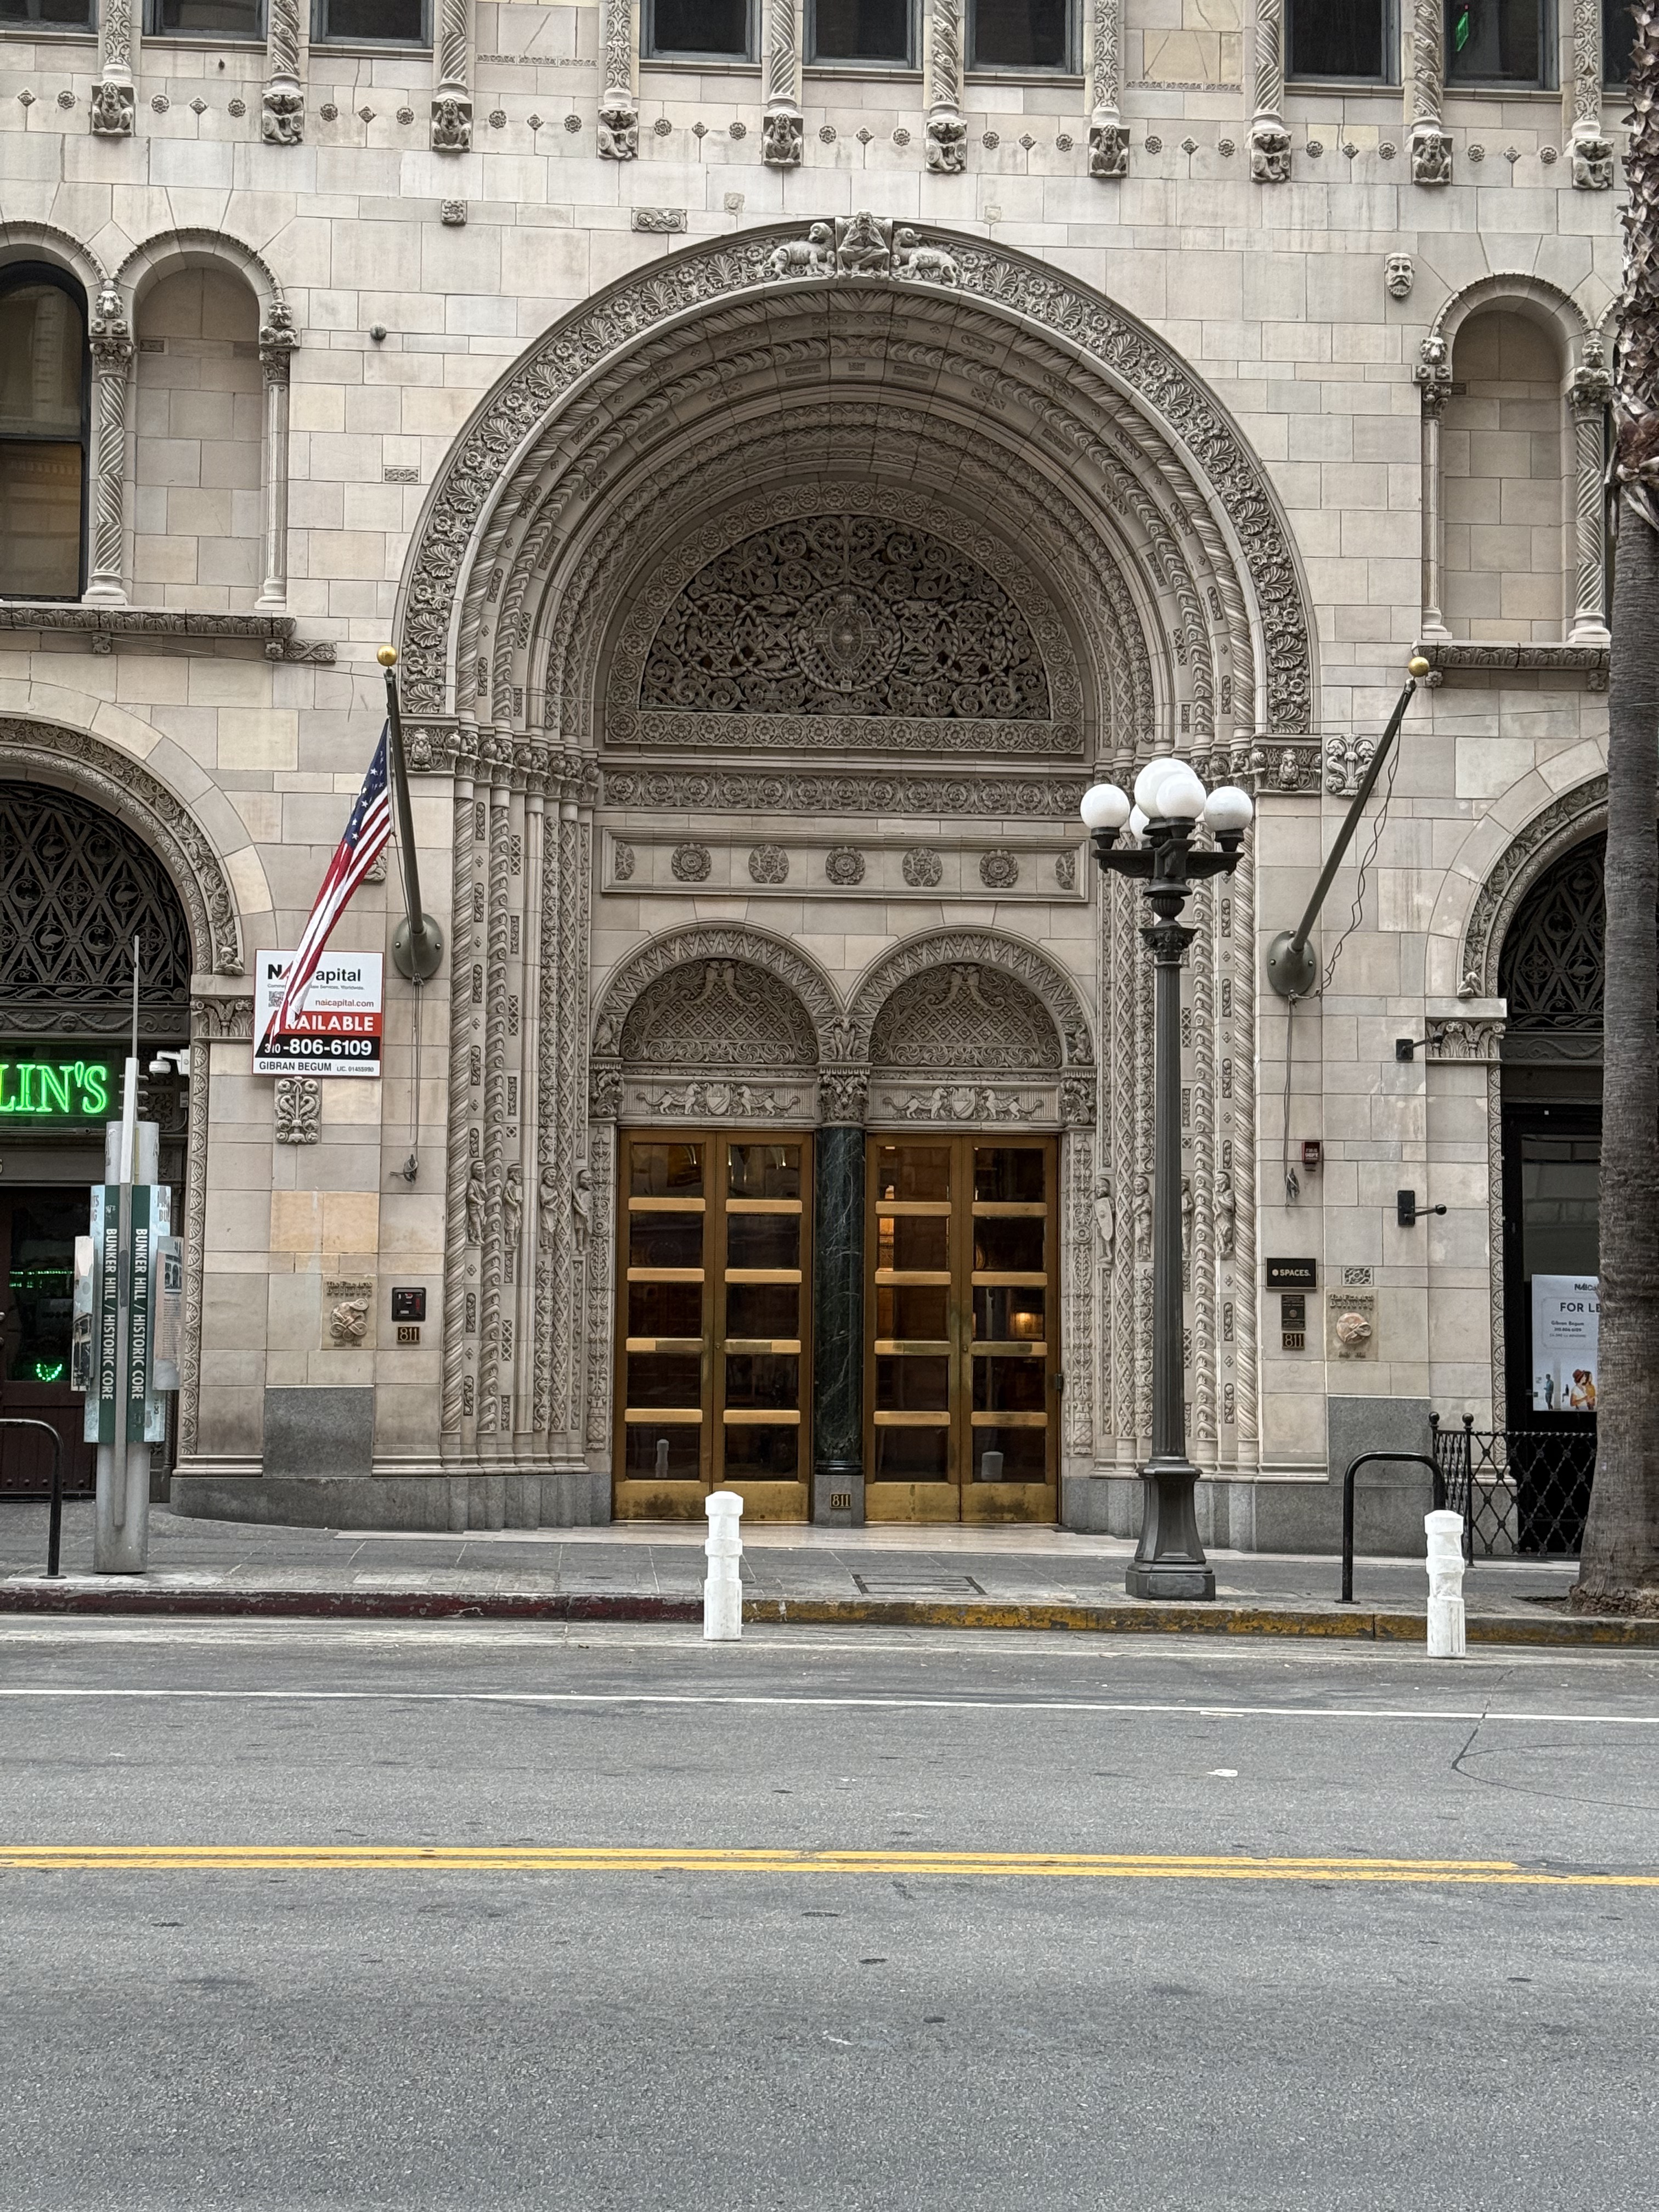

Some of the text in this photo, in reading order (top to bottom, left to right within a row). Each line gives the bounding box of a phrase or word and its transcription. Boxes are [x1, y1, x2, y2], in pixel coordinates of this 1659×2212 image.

[315, 999, 374, 1008] naicapital.com
[259, 1061, 295, 1071] GIBRAN
[298, 1062, 332, 1071] BEGUM
[105, 1228, 117, 1273] BUNKER
[134, 1228, 148, 1273] BUNKER
[104, 1277, 116, 1300] HILL
[133, 1277, 146, 1300] HILL
[1560, 1302, 1584, 1312] FOR
[103, 1314, 115, 1367] HISTORIC
[132, 1314, 145, 1367] HISTORIC
[399, 1328, 417, 1341] 811
[1285, 1334, 1301, 1347] 811
[101, 1370, 114, 1400] CORE
[131, 1370, 144, 1400] CORE
[832, 1494, 849, 1506] 811
